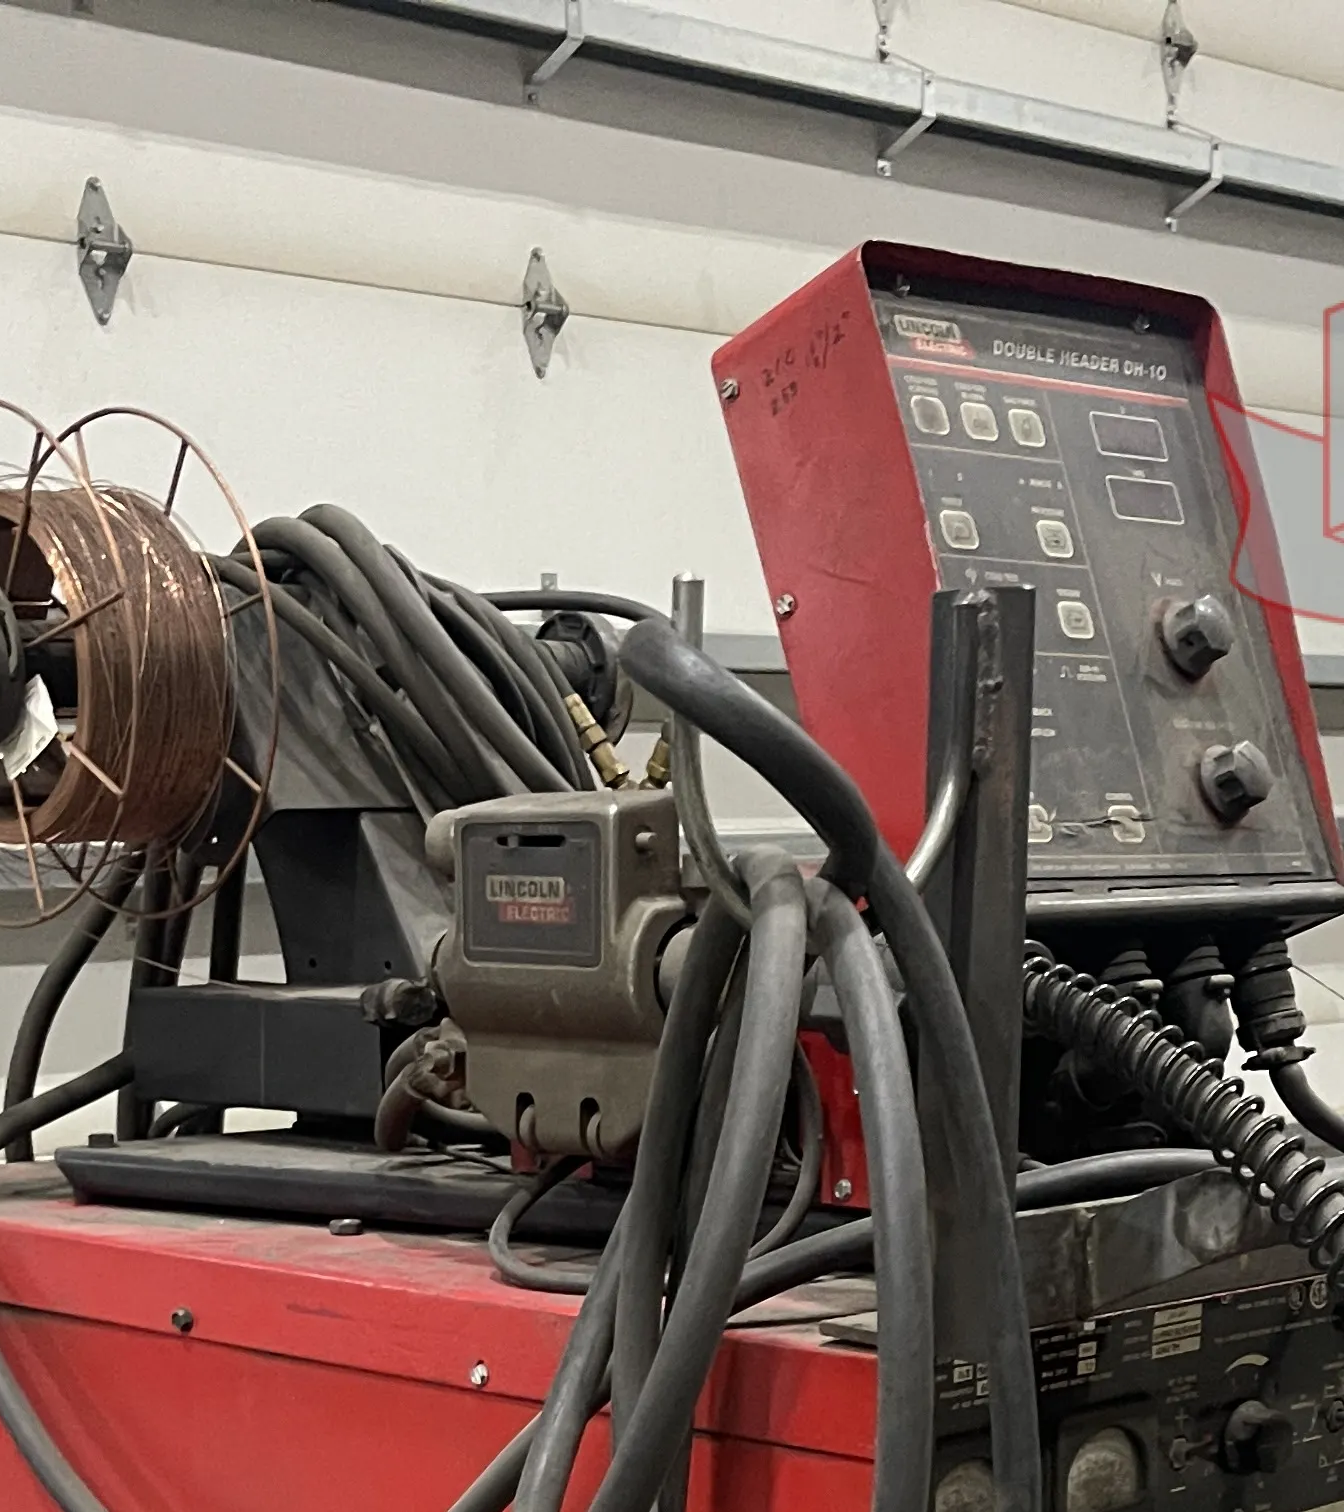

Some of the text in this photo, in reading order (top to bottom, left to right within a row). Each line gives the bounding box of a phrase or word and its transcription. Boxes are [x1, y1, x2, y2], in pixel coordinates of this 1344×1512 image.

[992, 340, 1167, 381] DOUBLE HEADER DH-10
[489, 880, 560, 898] LINCOLN
[506, 904, 570, 922] ELECTRIC
